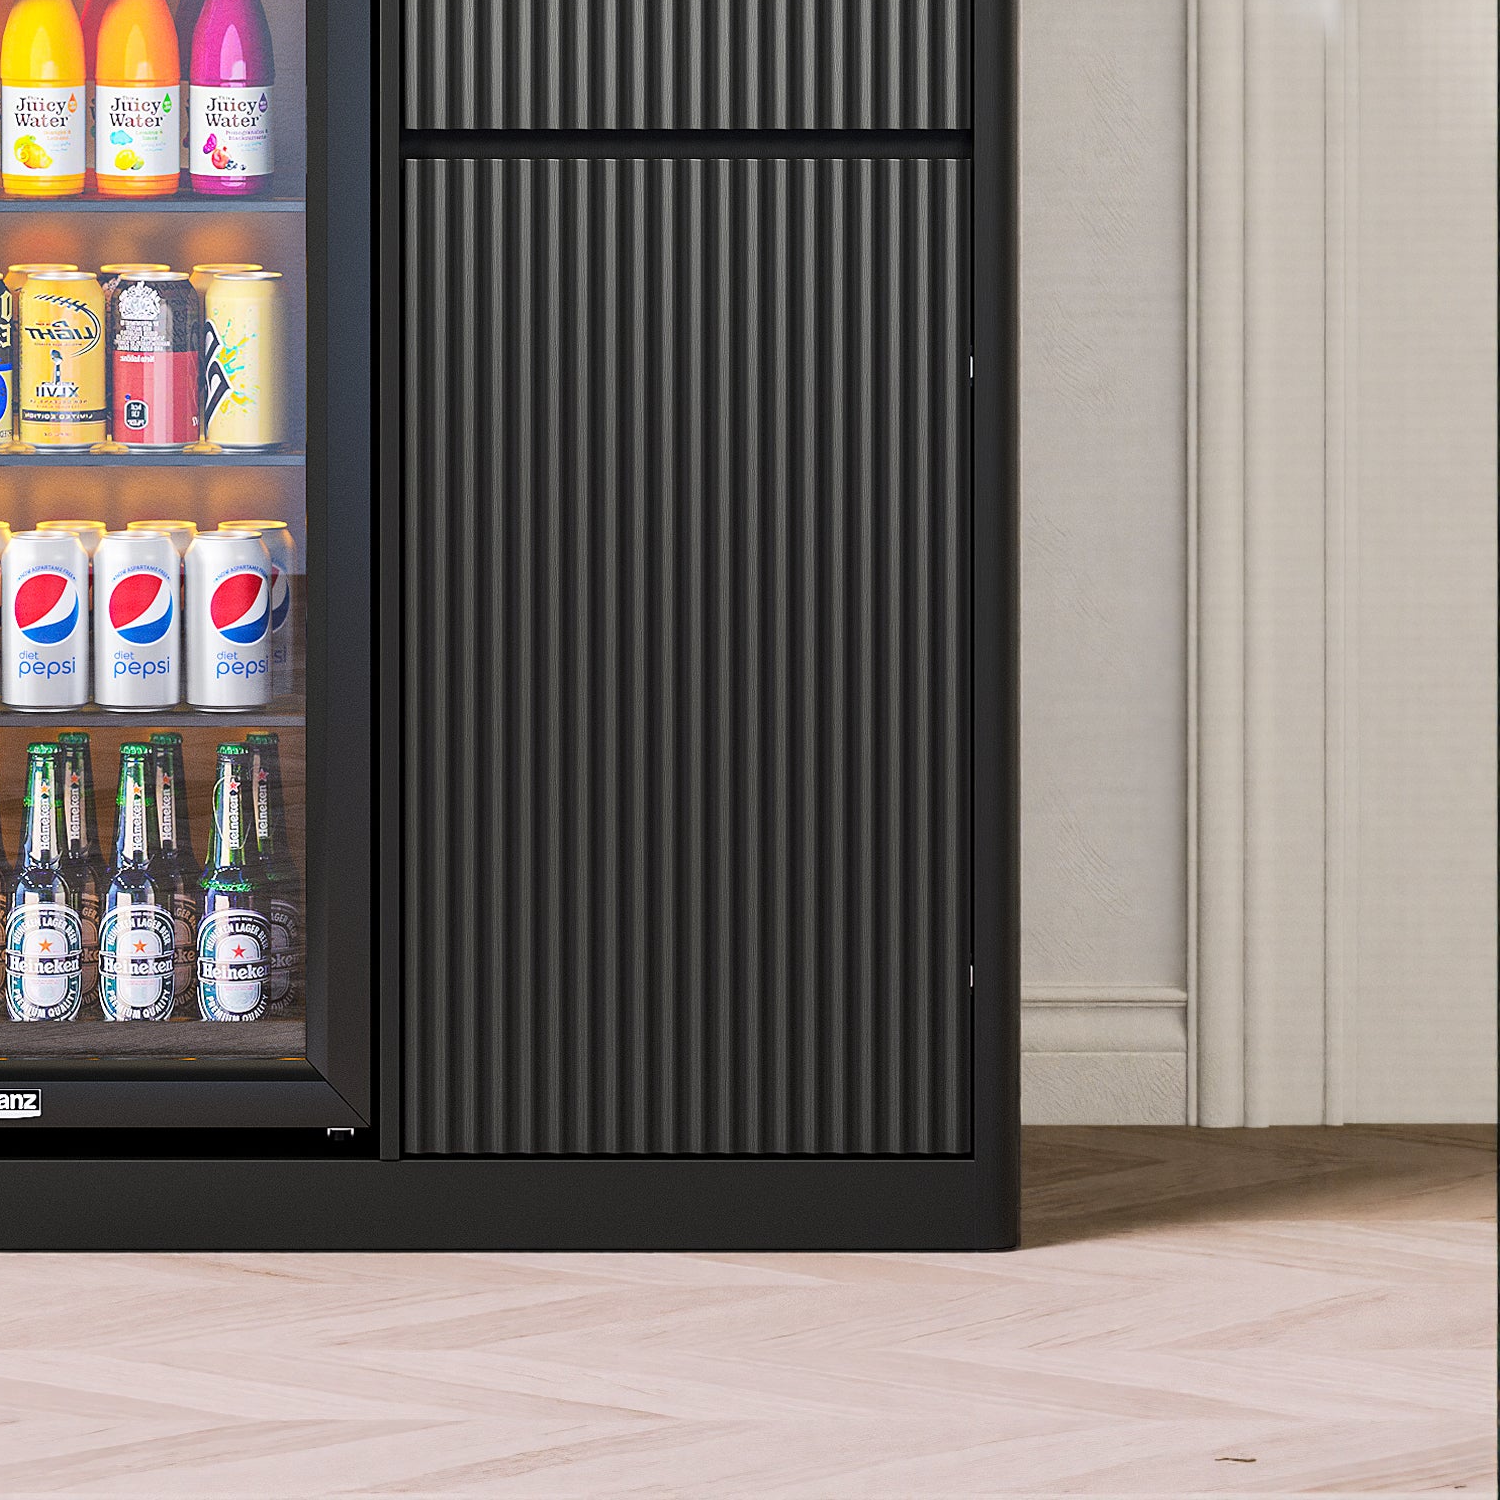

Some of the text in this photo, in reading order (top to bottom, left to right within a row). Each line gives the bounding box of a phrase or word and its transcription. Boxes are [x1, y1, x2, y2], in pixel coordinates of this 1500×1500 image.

[16, 97, 66, 115] Juicy
[110, 97, 161, 115] Juicy
[206, 97, 257, 115] Juicy
[15, 112, 69, 128] Water
[109, 112, 163, 128] Water
[205, 112, 260, 128] Water
[19, 650, 39, 660] diet
[114, 650, 135, 660] diet
[216, 650, 238, 660] diet
[19, 656, 76, 679] pepsi
[113, 656, 170, 679] pepsi
[216, 656, 269, 679] pepsi
[70, 787, 80, 840] Heineken
[162, 788, 172, 841] Heineken
[229, 794, 240, 850] Heineken
[259, 784, 268, 838] Heineken
[40, 796, 50, 850] Heineken
[82, 907, 97, 919] GER
[43, 916, 67, 930] LAGER
[65, 922, 78, 945] BEER
[136, 918, 162, 932] LAGER
[160, 924, 172, 946] BEER
[235, 922, 260, 936] LAGER
[258, 930, 269, 950] BEER
[10, 955, 79, 974] Heineken
[103, 956, 173, 975] Heineken
[47, 988, 77, 1018] QUALITY
[142, 989, 170, 1019] QUALITY
